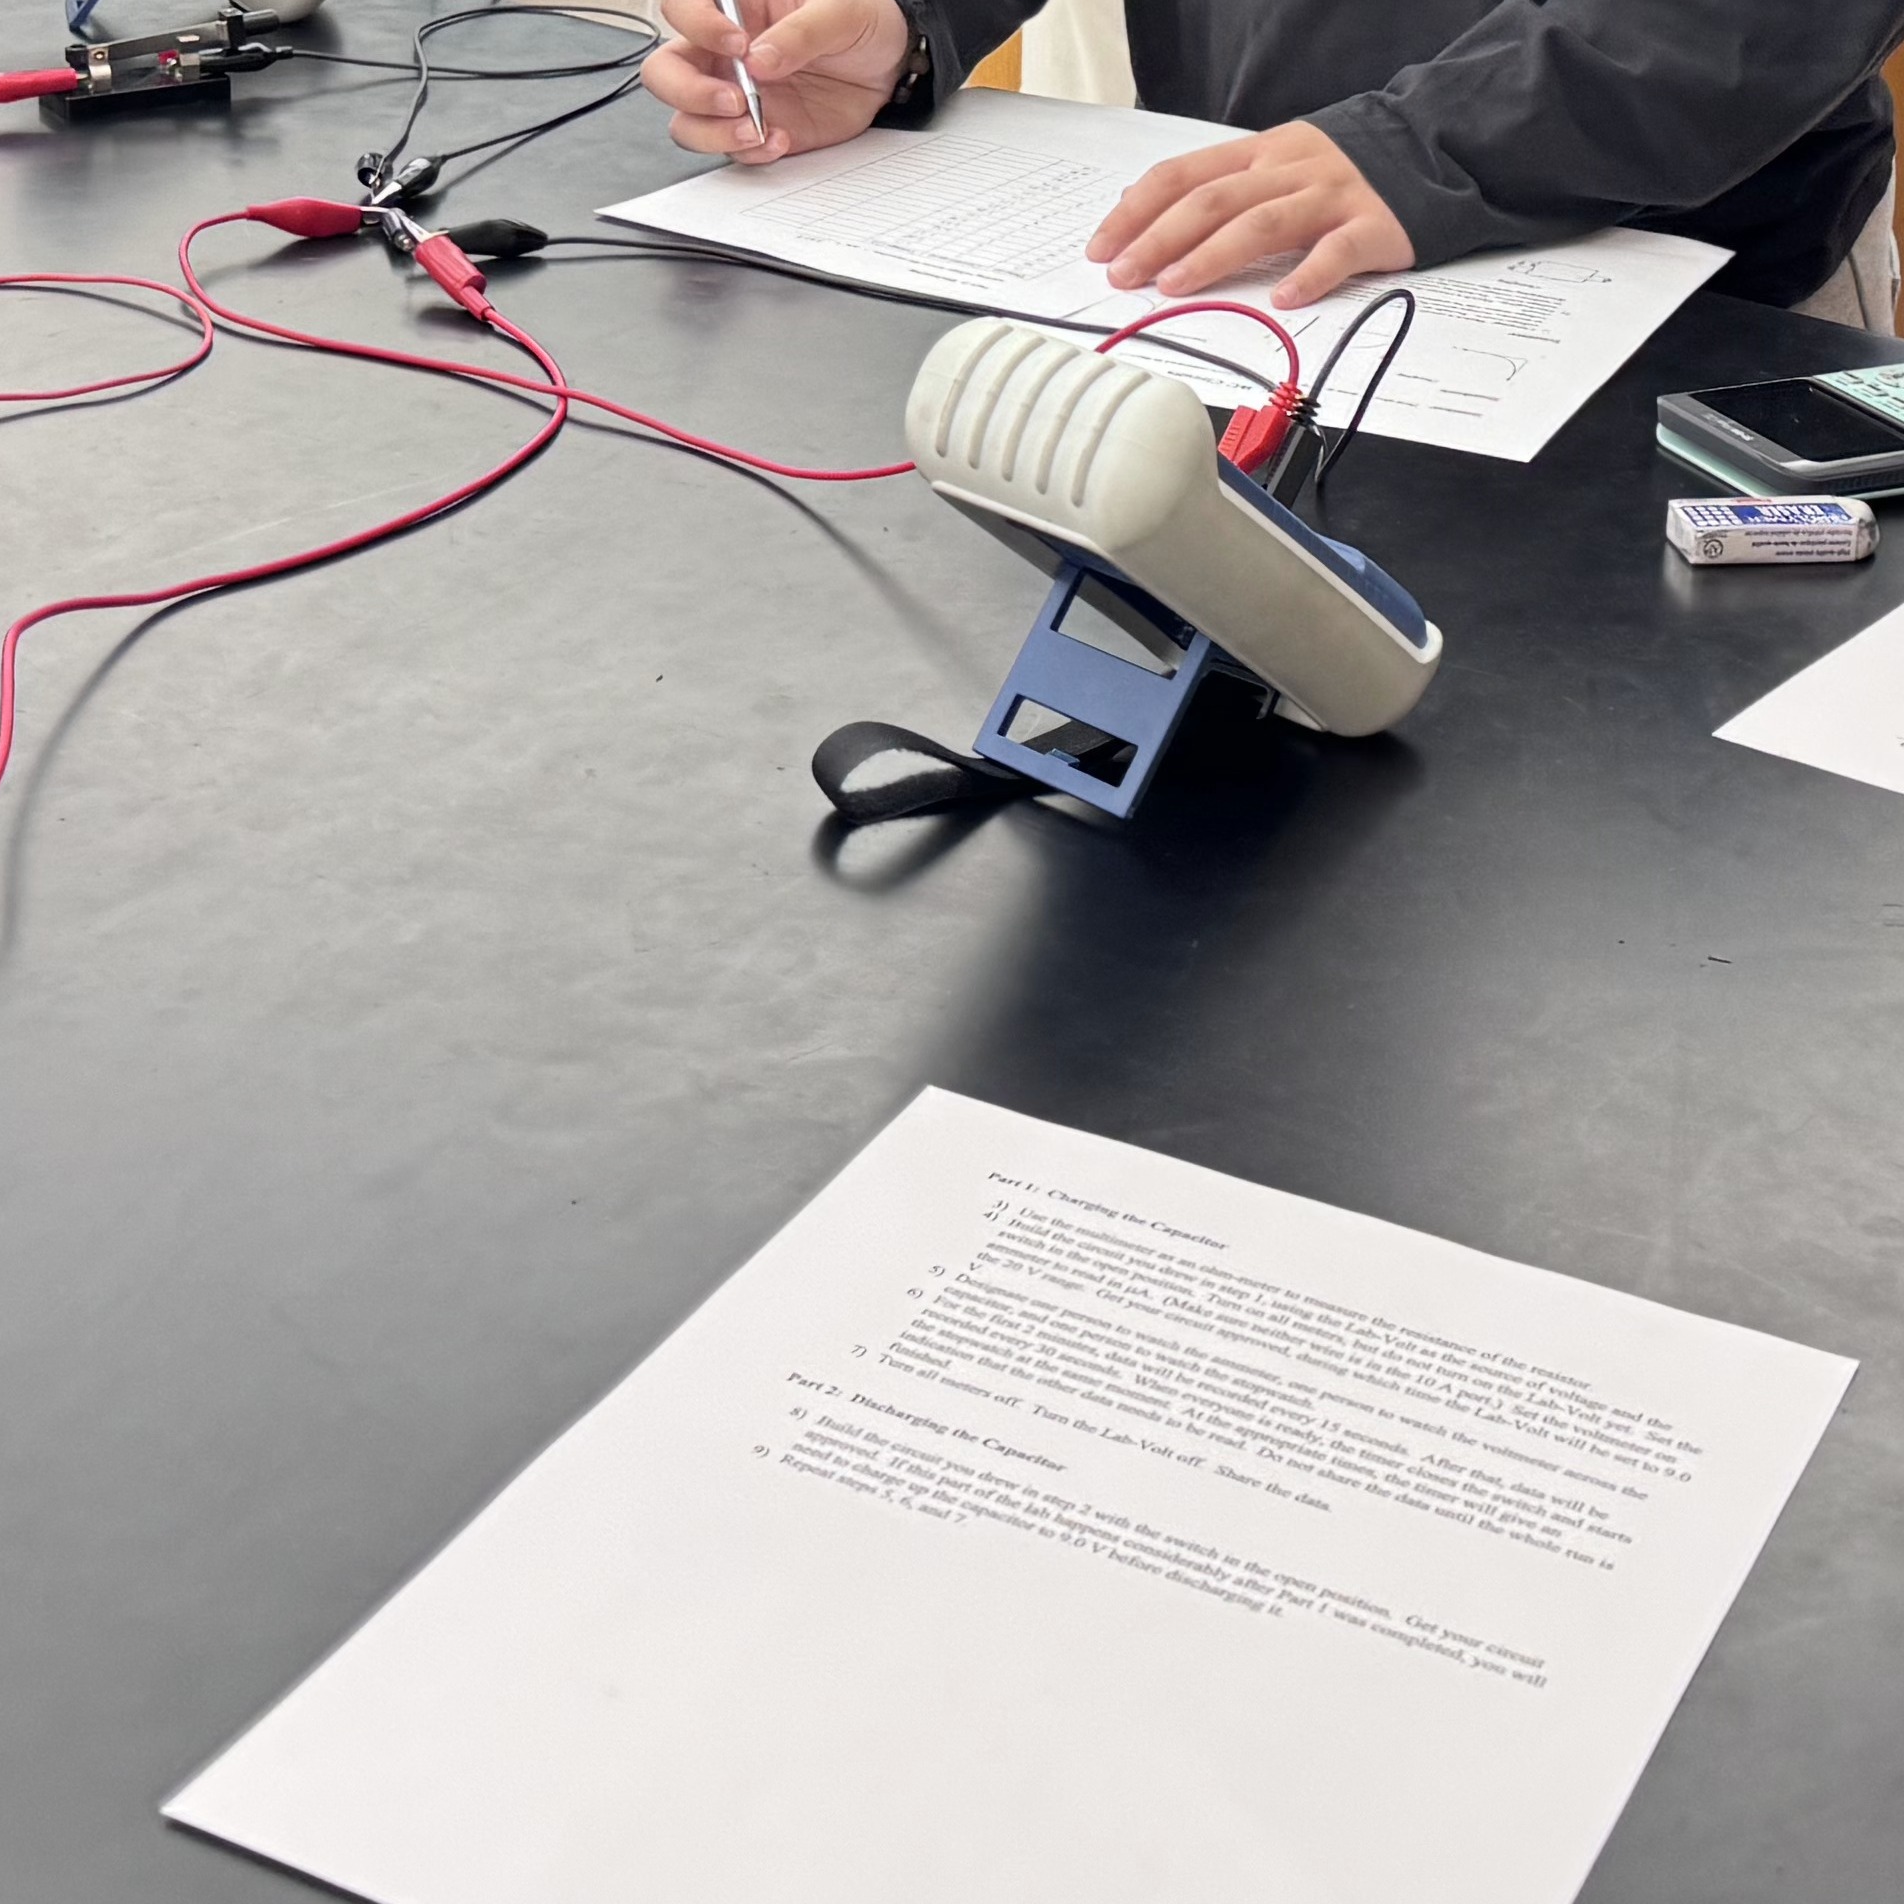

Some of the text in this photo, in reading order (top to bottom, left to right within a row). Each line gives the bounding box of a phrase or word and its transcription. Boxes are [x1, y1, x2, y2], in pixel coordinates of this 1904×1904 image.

[987, 1172, 1022, 1186] Part
[1047, 1189, 1118, 1218] Charging
[1121, 1213, 1146, 1225] the
[1150, 1221, 1228, 1249] Capacitor
[943, 1286, 1014, 1315] capacitor,
[1017, 1309, 1049, 1323] and
[1048, 1319, 1078, 1333] one
[1077, 1329, 1132, 1351] person
[1154, 1352, 1201, 1372] watch
[1203, 1367, 1230, 1381] the
[997, 1230, 1046, 1249] switch
[1065, 1250, 1091, 1263] the
[1091, 1259, 1129, 1276] open
[1202, 1292, 1242, 1311] Turn
[1266, 1313, 1290, 1325] all
[1291, 1321, 1346, 1345] meters,
[1351, 1338, 1379, 1353] but
[1404, 1357, 1433, 1370] not
[1435, 1365, 1469, 1382] turn
[1496, 1383, 1523, 1398] the
[1525, 1392, 1601, 1423] Lab-Volt
[1643, 1430, 1673, 1445] Set
[1676, 1441, 1702, 1454] the
[1008, 1218, 1051, 1236] Build
[1050, 1232, 1075, 1244] the
[1076, 1241, 1125, 1260] circuit
[1124, 1256, 1156, 1270] you
[1157, 1265, 1198, 1282] drew
[1217, 1284, 1250, 1299] step
[1270, 1300, 1314, 1320] using
[1316, 1313, 1342, 1328] the
[1344, 1321, 1417, 1351] Lab-Volt
[1440, 1353, 1467, 1366] the
[1469, 1362, 1523, 1384] source
[1548, 1386, 1607, 1410] voltage
[1610, 1408, 1643, 1421] and
[1646, 1417, 1672, 1430] the
[1018, 1207, 1048, 1222] Use
[1049, 1217, 1074, 1230] the
[1074, 1226, 1156, 1255] multimeter
[1198, 1265, 1281, 1293] ohm-meter
[1303, 1296, 1368, 1321] measure
[1370, 1316, 1396, 1330] the
[1399, 1327, 1476, 1355] resistance
[1501, 1356, 1527, 1370] the
[779, 1453, 836, 1479] Repeat
[835, 1475, 878, 1494] steps
[916, 1503, 952, 1519] and
[786, 1372, 824, 1390] Part
[850, 1393, 948, 1434] Discharging
[951, 1428, 979, 1442] the
[982, 1438, 1066, 1471] Capacitor
[878, 1352, 914, 1372] Turn
[915, 1369, 939, 1380] all
[939, 1376, 991, 1397] meters
[1032, 1403, 1069, 1424] Turn
[1072, 1419, 1097, 1433] the
[1099, 1427, 1174, 1457] Lab-Volt
[1213, 1464, 1262, 1486] Share
[1264, 1482, 1292, 1496] the
[791, 1442, 833, 1461] need
[850, 1463, 906, 1486] charge
[930, 1489, 959, 1504] the
[959, 1500, 1036, 1530] capacitor
[1059, 1531, 1087, 1547] 9.0
[1107, 1547, 1162, 1574] before
[1164, 1569, 1264, 1611] discharging
[815, 1415, 863, 1437] Build
[862, 1431, 890, 1446] the
[889, 1442, 944, 1464] circuit
[940, 1460, 975, 1476] you
[977, 1471, 1020, 1490] drew
[1041, 1493, 1076, 1510] step
[1094, 1510, 1130, 1529] with
[1133, 1523, 1161, 1539] the
[1163, 1535, 1219, 1558] switch
[1243, 1561, 1271, 1576] the
[1273, 1573, 1317, 1592] open
[1404, 1614, 1438, 1633] Get
[1439, 1628, 1484, 1648] your
[1485, 1644, 1544, 1668] circuit
